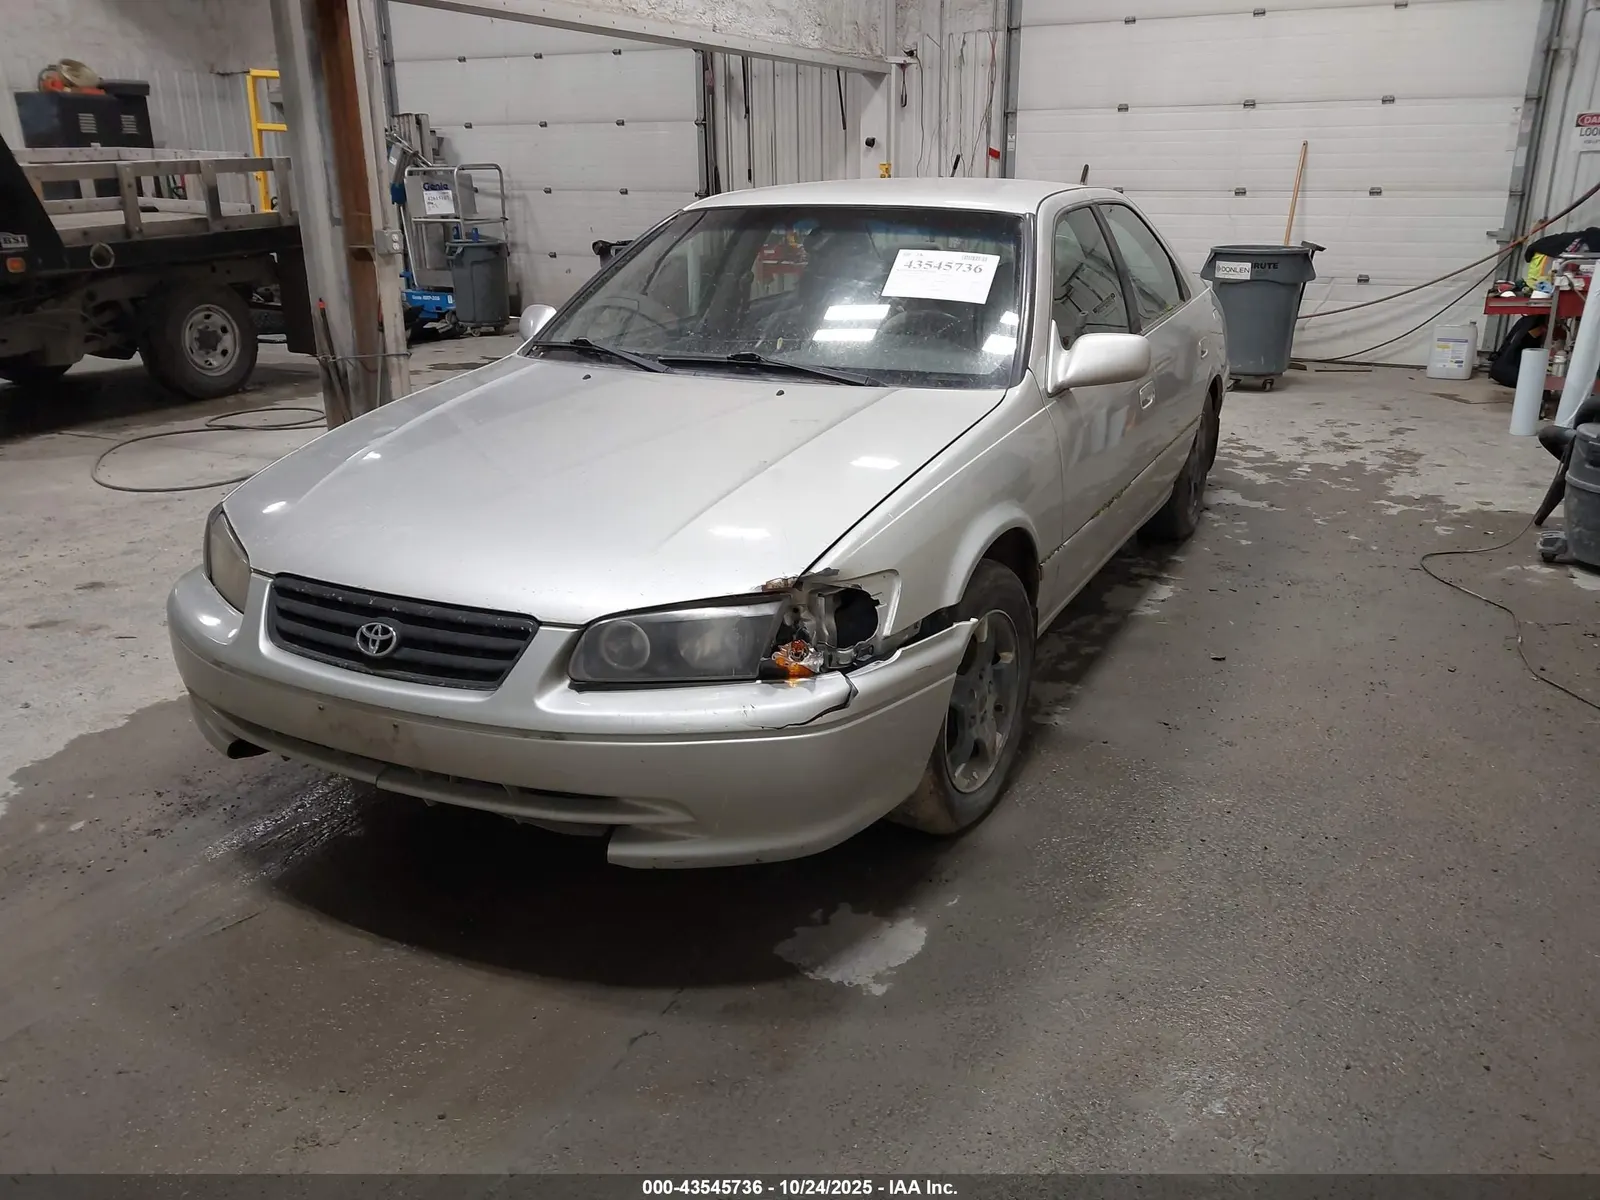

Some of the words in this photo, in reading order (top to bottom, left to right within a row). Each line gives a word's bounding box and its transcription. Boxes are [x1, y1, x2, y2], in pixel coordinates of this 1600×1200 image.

[1580, 127, 1600, 137] LOO
[423, 182, 450, 191] Genie
[903, 259, 983, 274] 43545736
[1251, 262, 1279, 270] RUTE
